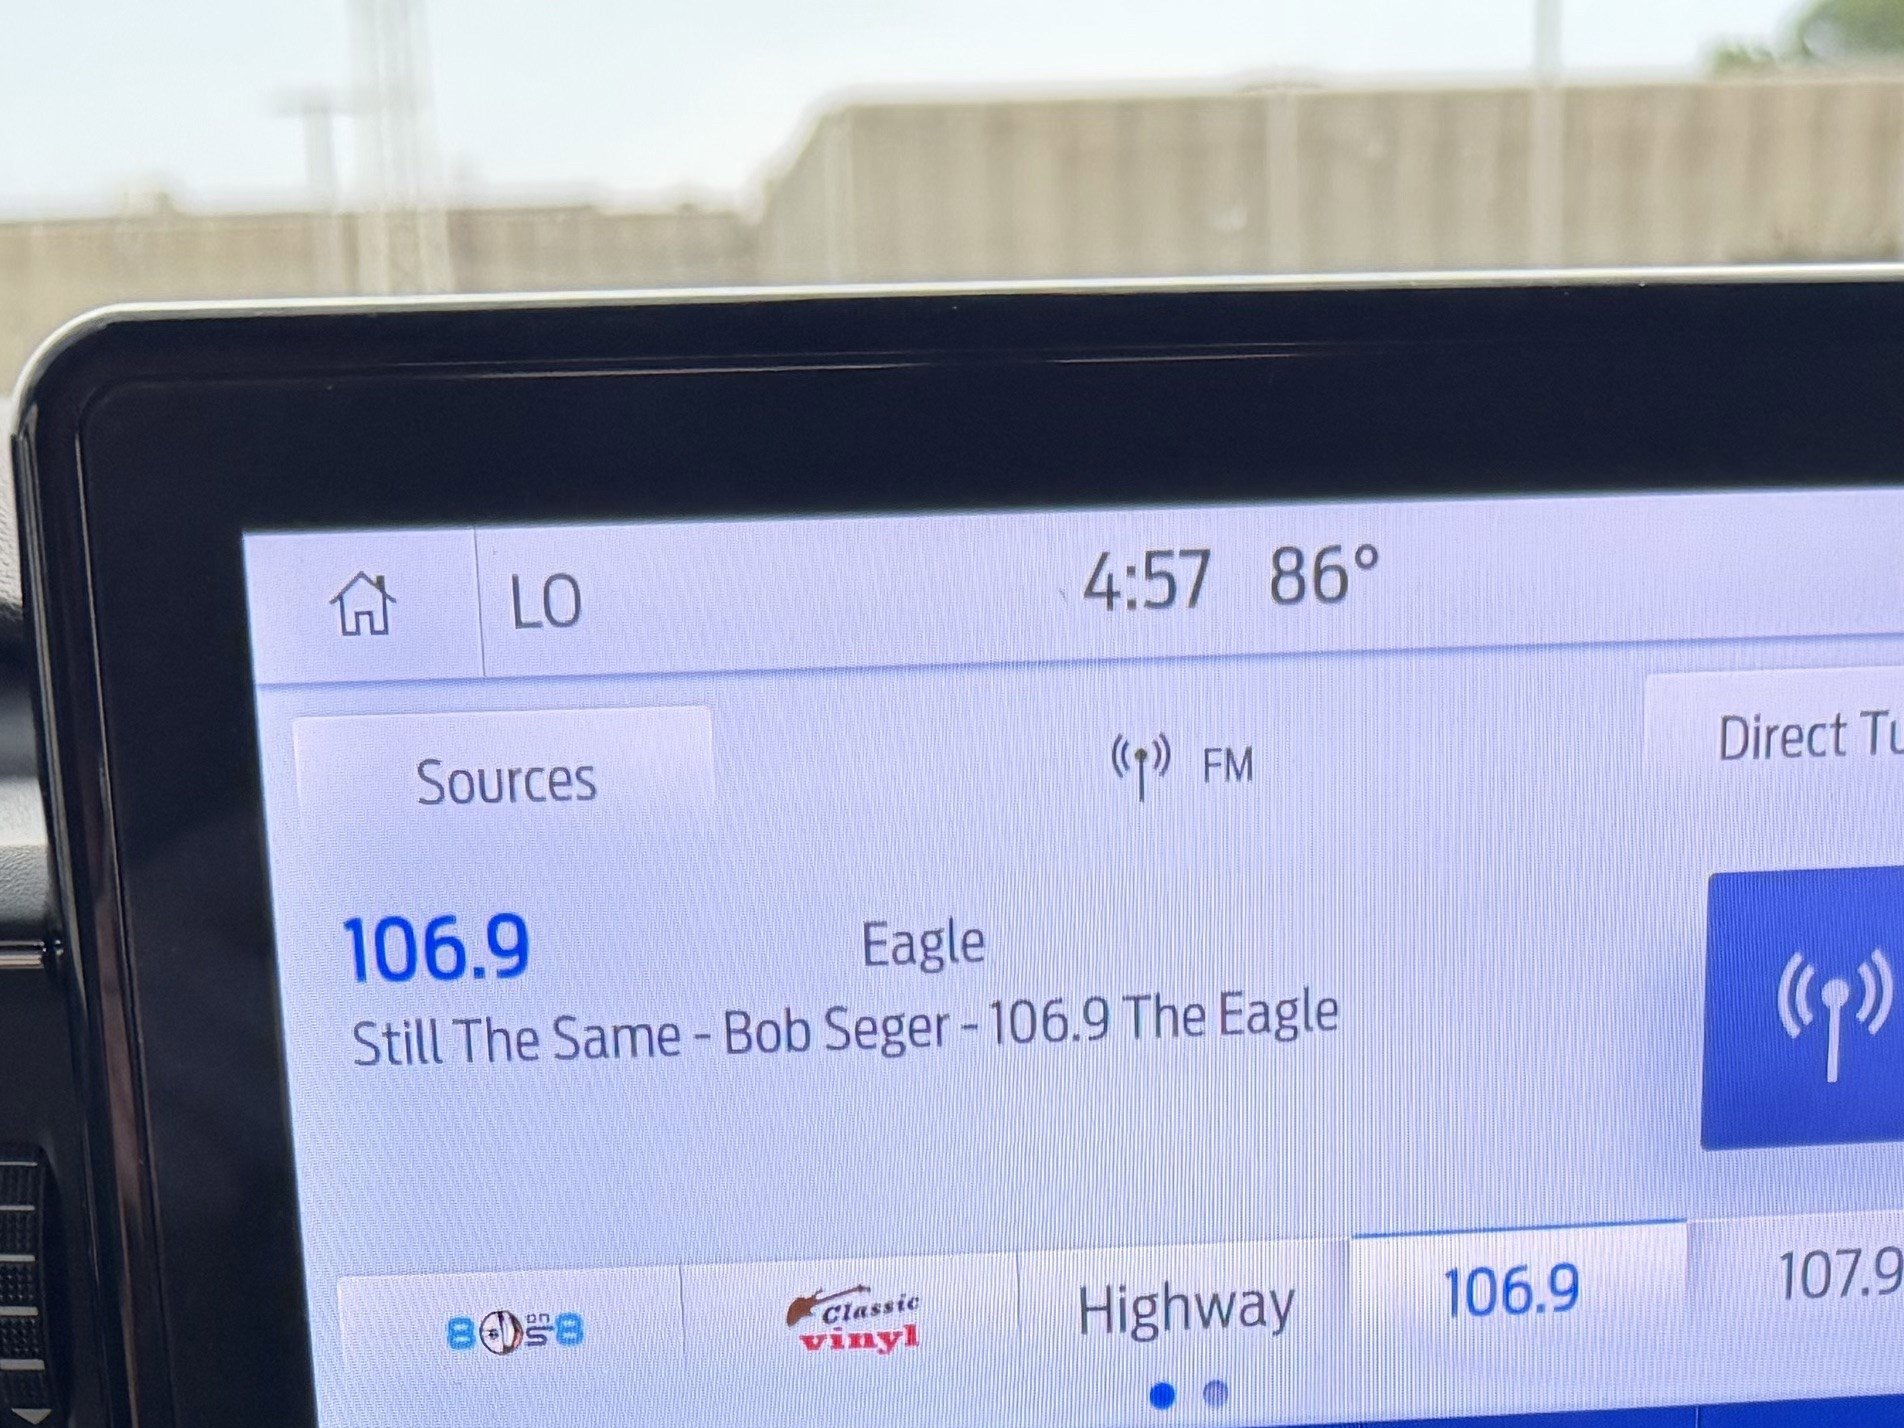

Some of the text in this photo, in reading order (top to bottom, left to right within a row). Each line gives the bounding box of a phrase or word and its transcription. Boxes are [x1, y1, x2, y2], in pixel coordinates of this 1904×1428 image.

[511, 572, 582, 630] LO
[1084, 543, 1380, 611] 4:57 86°
[1203, 746, 1254, 783] FM
[1720, 714, 1848, 761] Direct
[417, 757, 598, 806] Sources
[344, 912, 530, 983] 106.9
[863, 917, 986, 974] Eagle
[353, 1018, 443, 1067] Still
[452, 1016, 541, 1063] The
[552, 1014, 682, 1061] Same
[724, 1007, 812, 1055] Bob
[824, 1004, 950, 1059] Seger
[991, 995, 1111, 1045] 106.9
[1122, 992, 1206, 1039] The
[1220, 985, 1340, 1043] Eagle
[1446, 1262, 1580, 1318] 106.9
[1781, 1245, 1904, 1300] 107.9
[821, 1290, 921, 1326] Classic
[1079, 1281, 1295, 1344] Highway
[799, 1323, 921, 1355] vinyl
